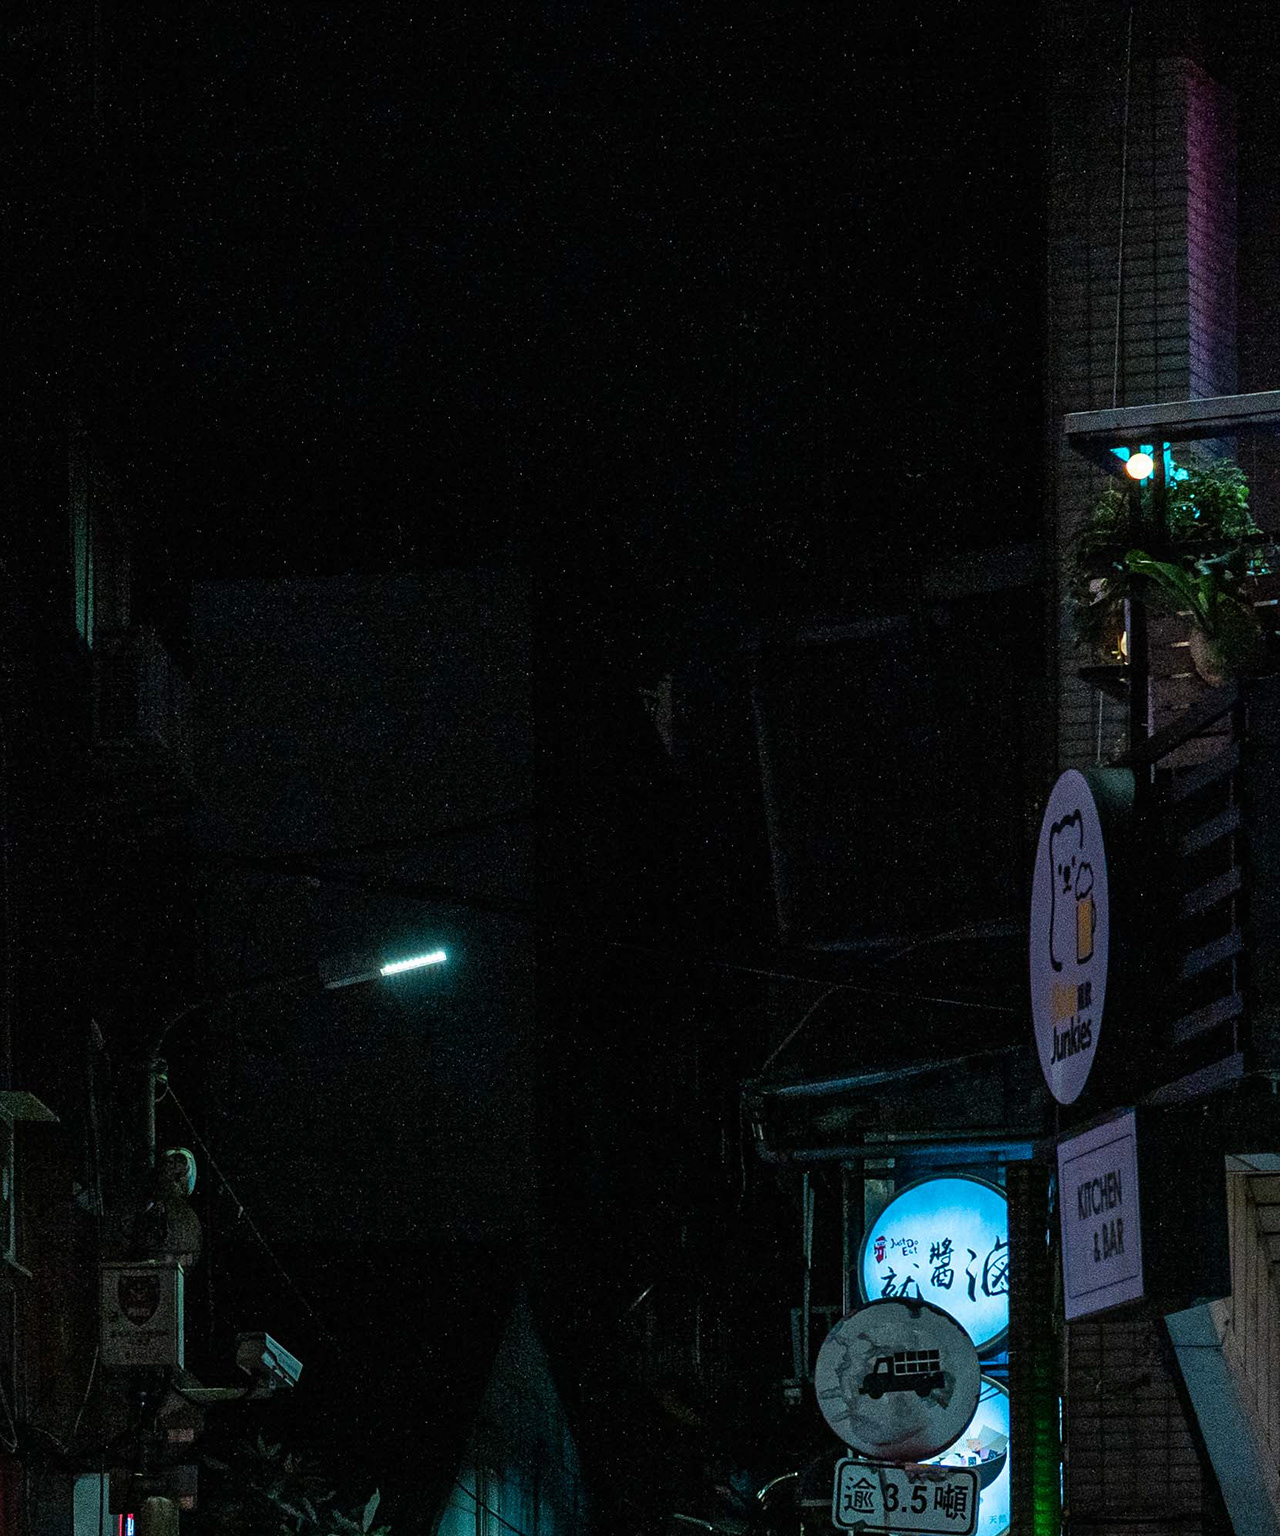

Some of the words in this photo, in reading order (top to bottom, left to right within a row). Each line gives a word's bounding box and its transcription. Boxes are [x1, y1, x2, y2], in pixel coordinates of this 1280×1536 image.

[1051, 1016, 1092, 1065] Junkies
[1078, 1169, 1122, 1221] KITCHEN
[1102, 1218, 1124, 1260] BAR
[844, 1477, 967, 1520] 逾3.5噸
